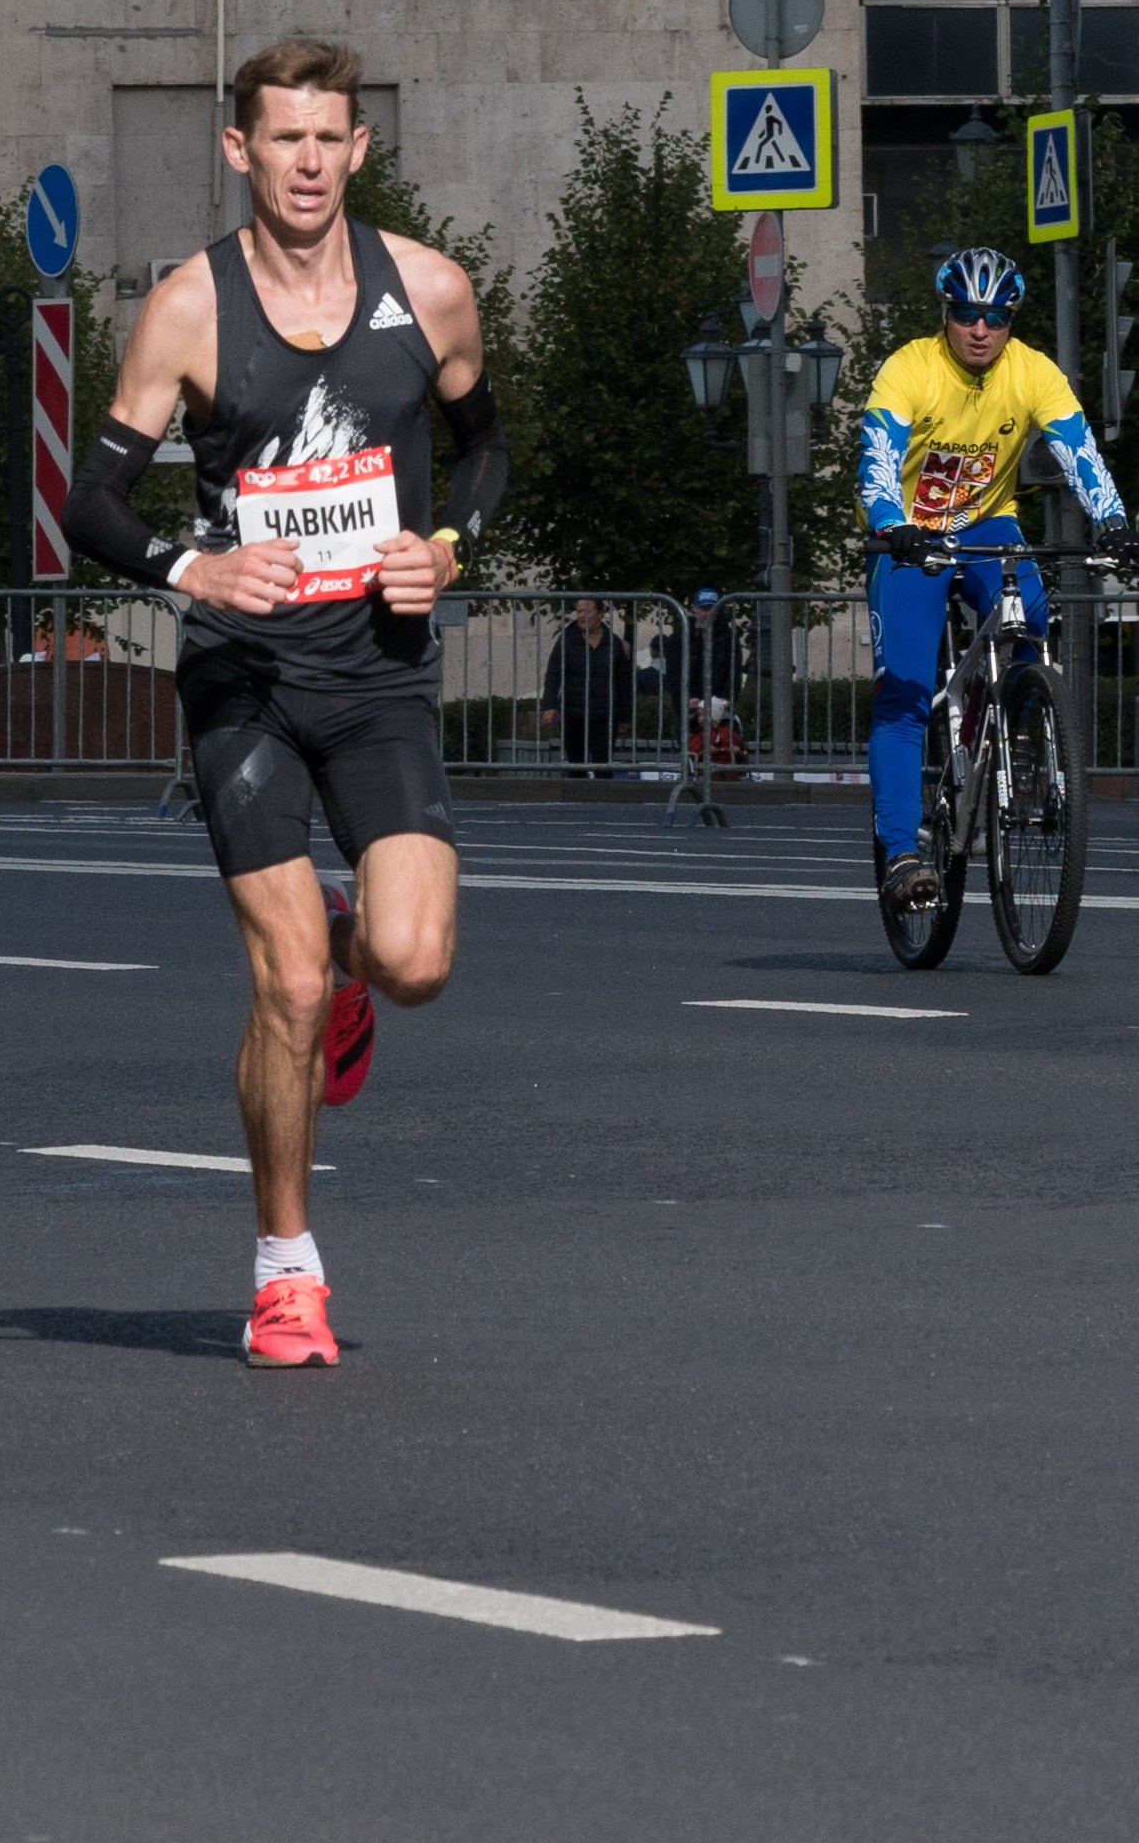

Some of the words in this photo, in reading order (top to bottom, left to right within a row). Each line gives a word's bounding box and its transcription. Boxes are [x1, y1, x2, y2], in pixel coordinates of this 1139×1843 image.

[369, 313, 413, 330] adidas
[928, 439, 999, 455] МАРАФОН
[308, 462, 350, 484] 42,2
[264, 498, 376, 538] ЧАВКИН
[317, 550, 332, 563] 11
